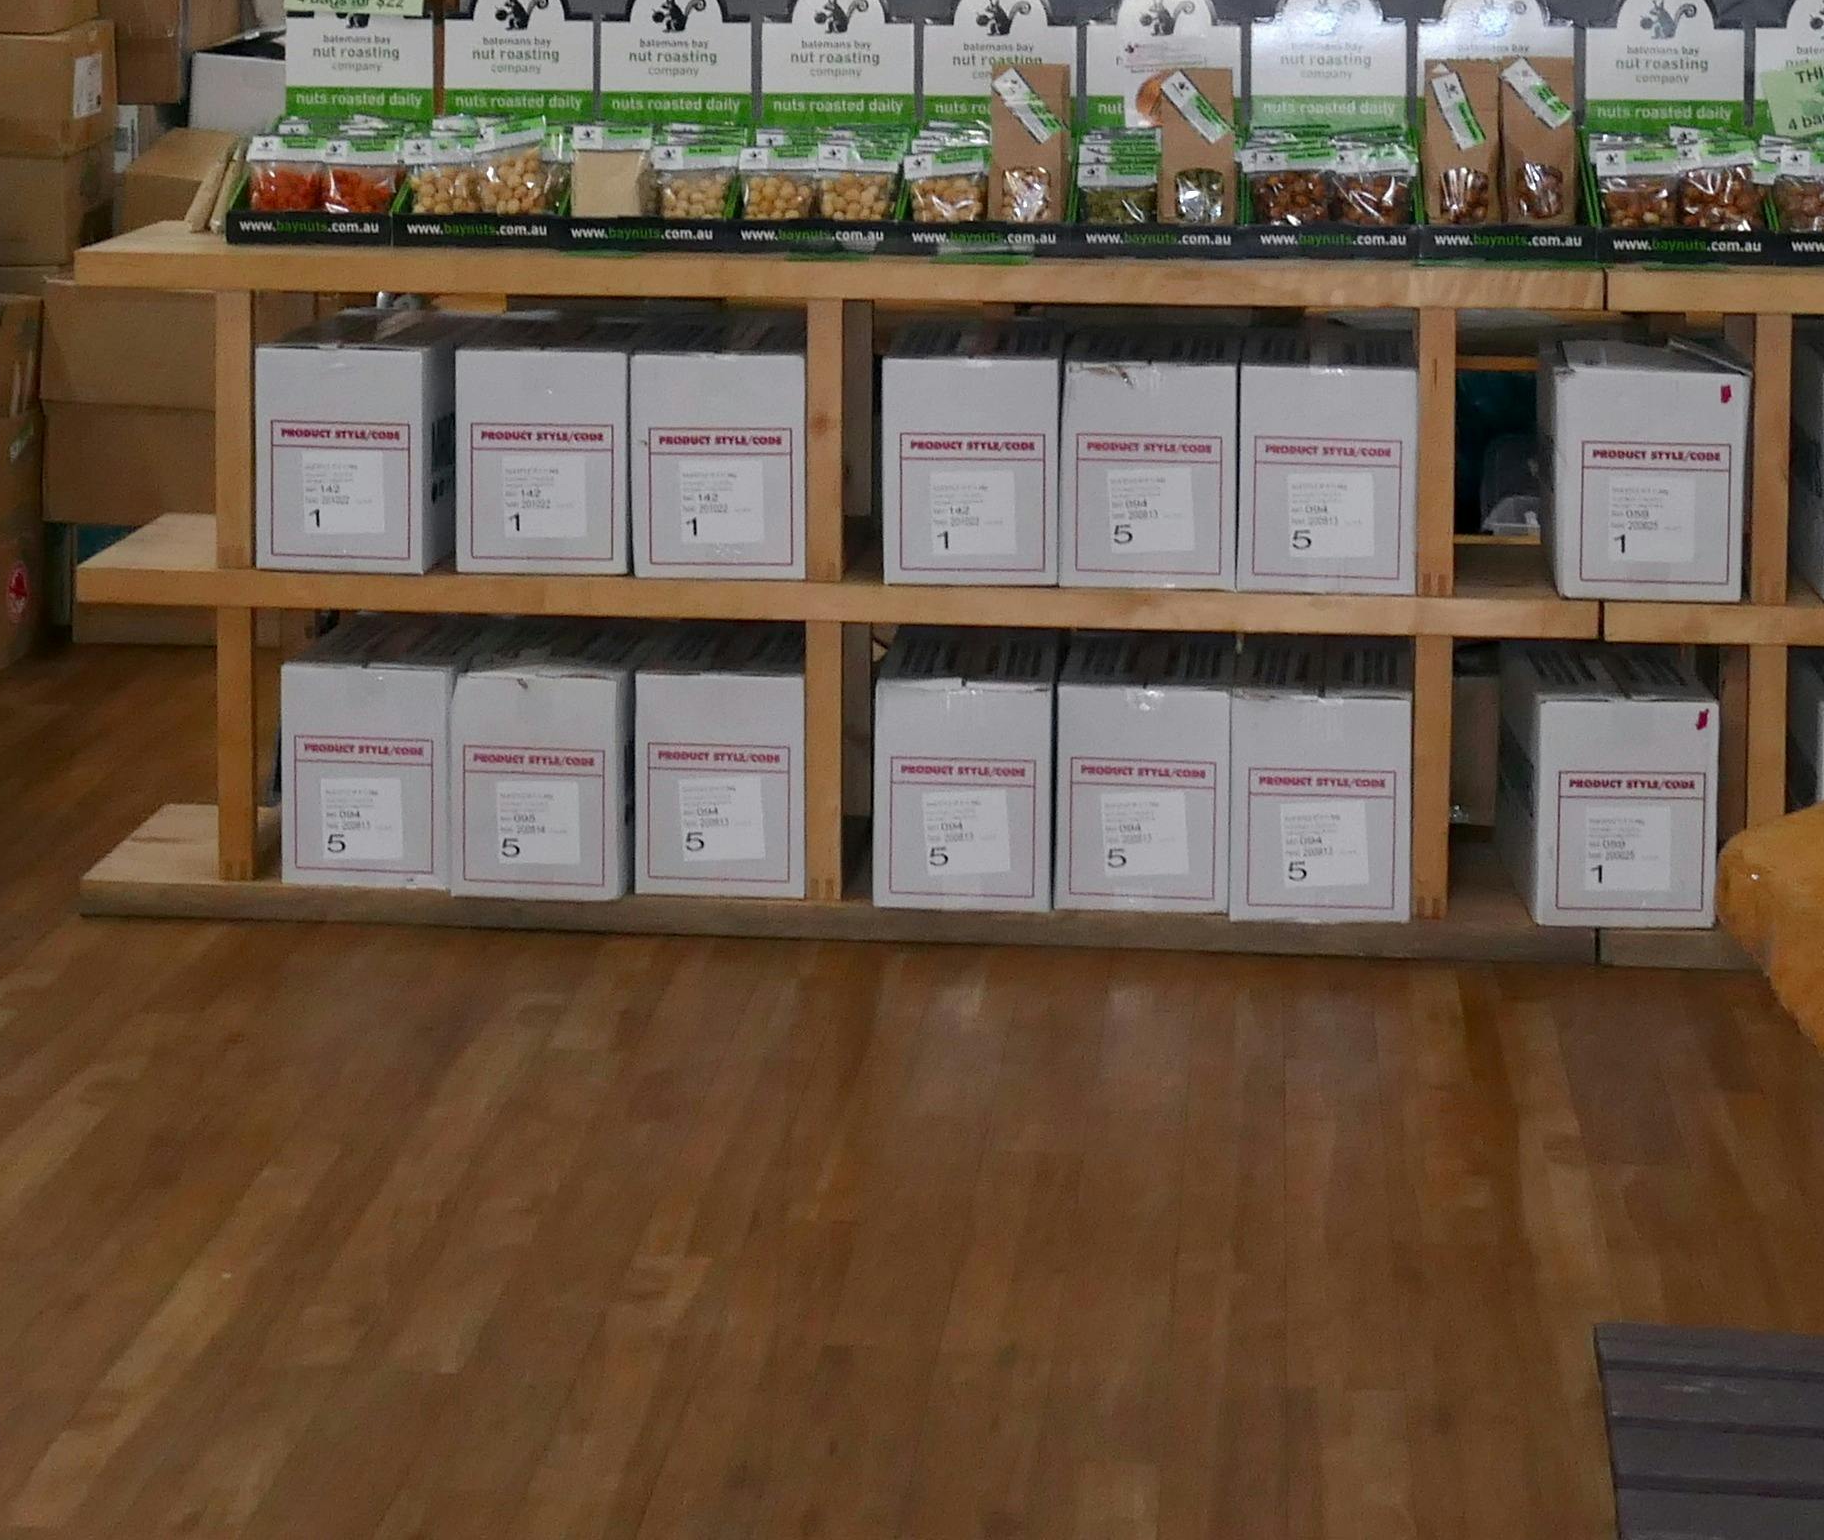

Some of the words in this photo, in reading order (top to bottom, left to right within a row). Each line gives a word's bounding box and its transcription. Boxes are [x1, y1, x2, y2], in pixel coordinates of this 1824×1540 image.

[472, 48, 496, 60] nut
[499, 48, 560, 62] roasting
[491, 63, 541, 75] company
[490, 95, 545, 108] roasted
[548, 95, 583, 111] daily
[239, 218, 380, 236] www.baynuts.com.au
[406, 221, 548, 239] www.baynuts.com.au
[1612, 237, 1762, 257] www.baynuts.com.au
[281, 428, 331, 440] PRODUCT
[334, 429, 401, 442] STYLE/CODE
[910, 440, 963, 452] PRODUCT
[966, 440, 1036, 453] STYLE/CODE
[1593, 448, 1648, 460] PRODUCT
[1650, 450, 1722, 463] STYLE/CODE
[308, 509, 321, 528] 1
[1112, 524, 1134, 545] 5
[1613, 534, 1627, 554] 1
